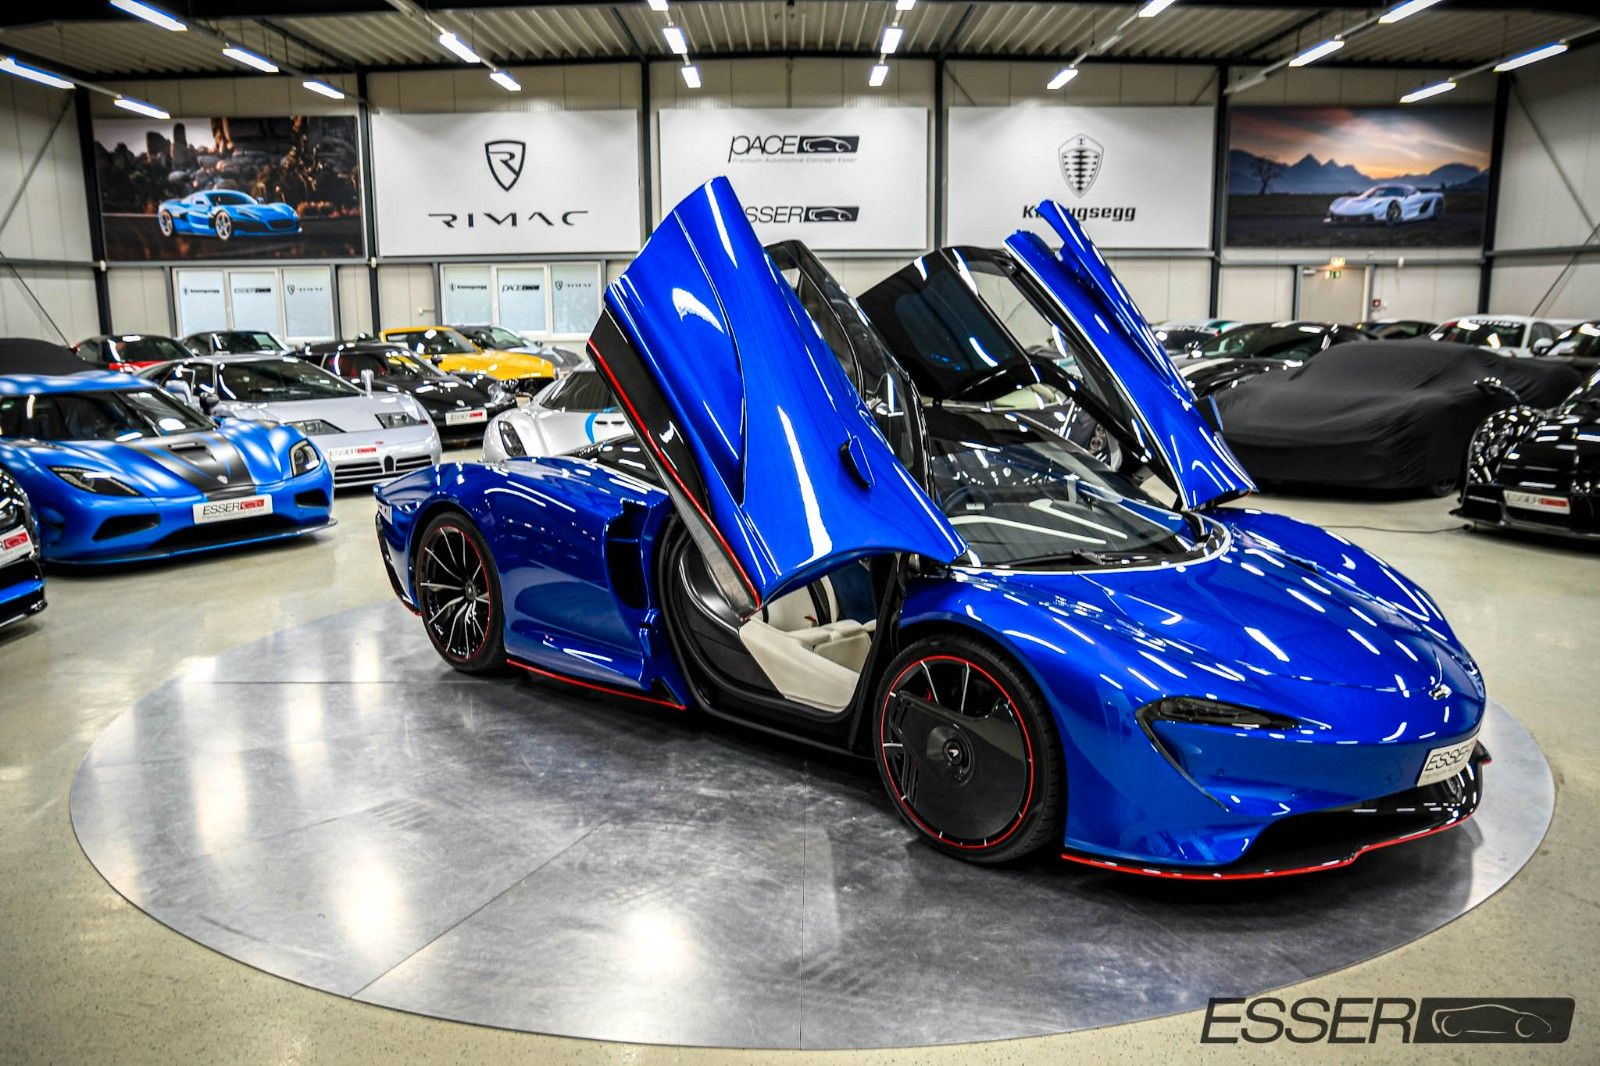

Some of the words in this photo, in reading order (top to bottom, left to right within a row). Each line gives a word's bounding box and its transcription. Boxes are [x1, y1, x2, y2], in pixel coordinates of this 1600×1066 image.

[428, 210, 589, 228] RIMAC
[743, 206, 804, 224] SSER
[203, 501, 240, 515] ESSER
